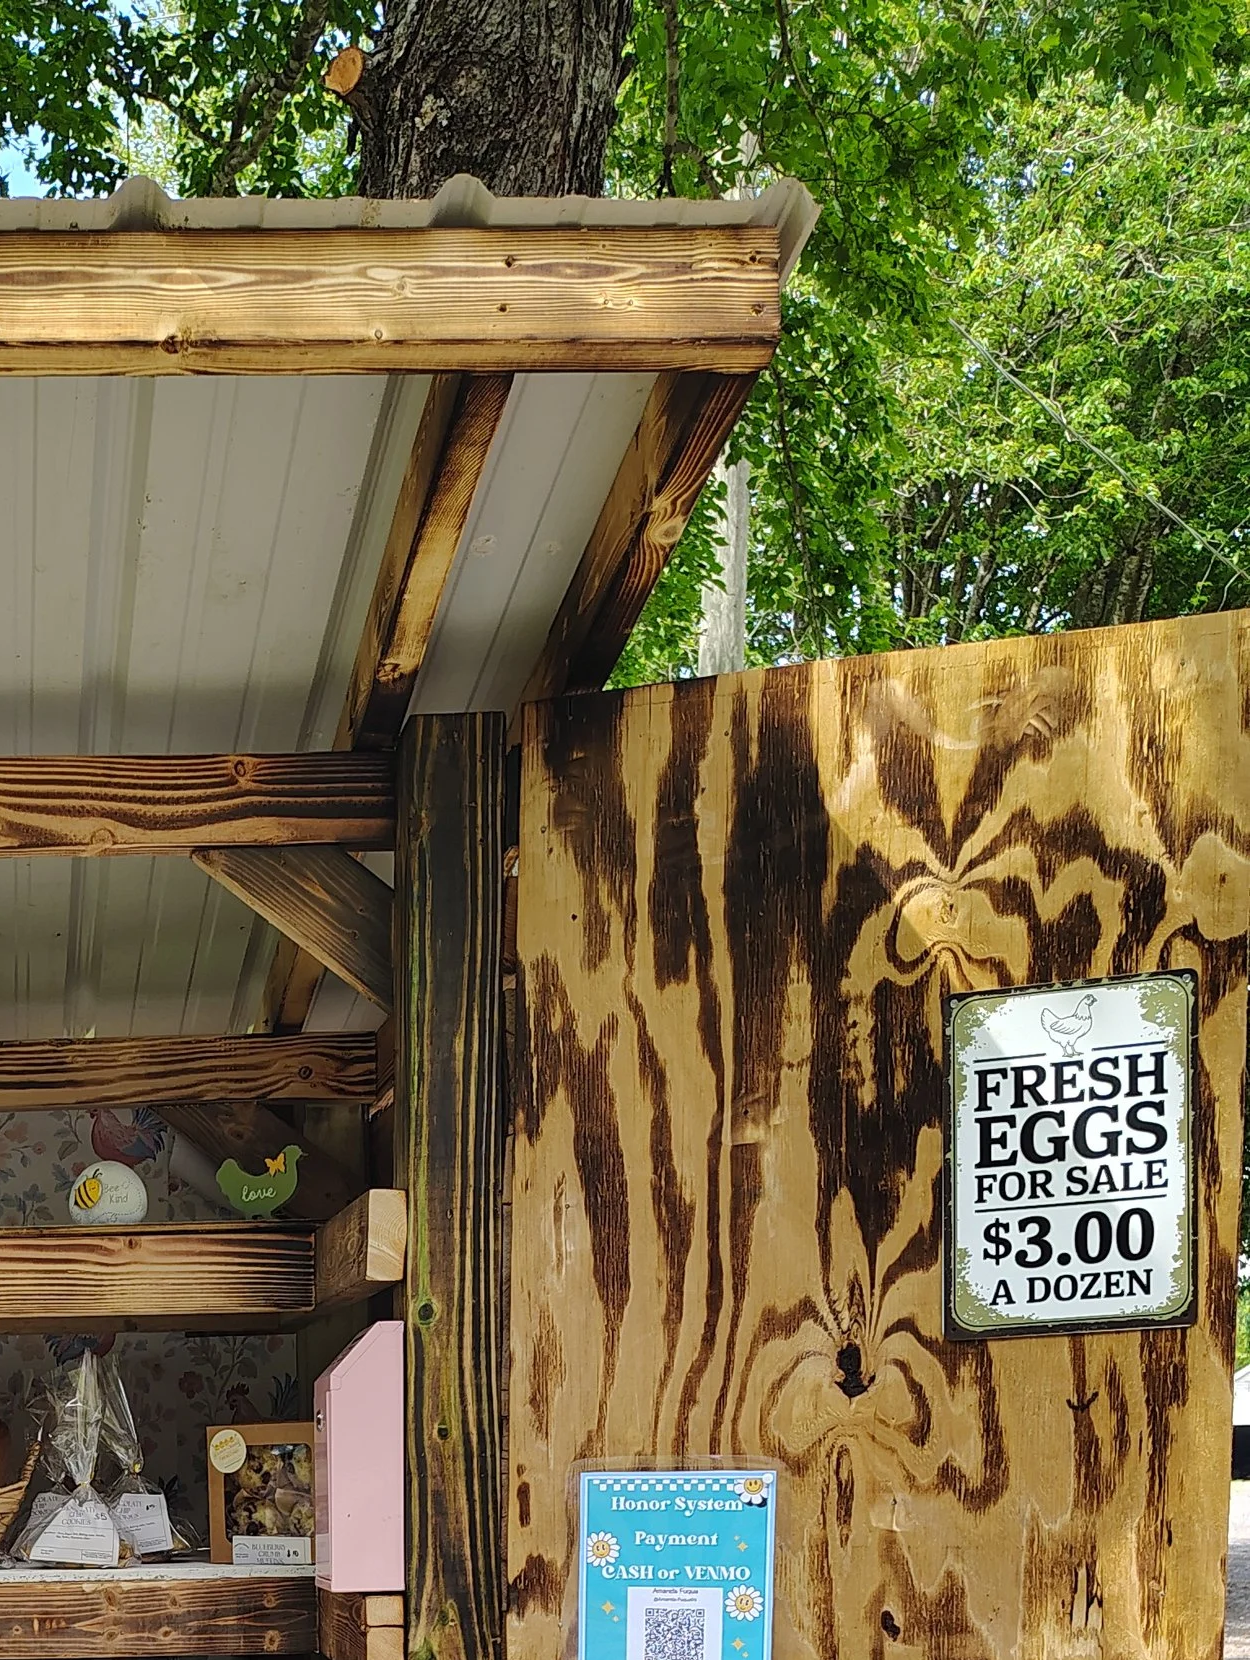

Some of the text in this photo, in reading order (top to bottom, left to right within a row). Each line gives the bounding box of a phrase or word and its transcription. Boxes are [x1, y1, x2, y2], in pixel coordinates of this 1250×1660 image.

[973, 1051, 1168, 1112] FRESH
[974, 1100, 1168, 1169] EGGS
[104, 1184, 120, 1194] Bee
[241, 1187, 276, 1202] love
[974, 1159, 1169, 1204] FOR SALE
[982, 1208, 1155, 1268] $3.00
[989, 1269, 1154, 1306] A DOZEN
[611, 1496, 744, 1517] Honor System
[634, 1531, 718, 1551] Payment
[601, 1565, 751, 1580] CASH or VENMO
